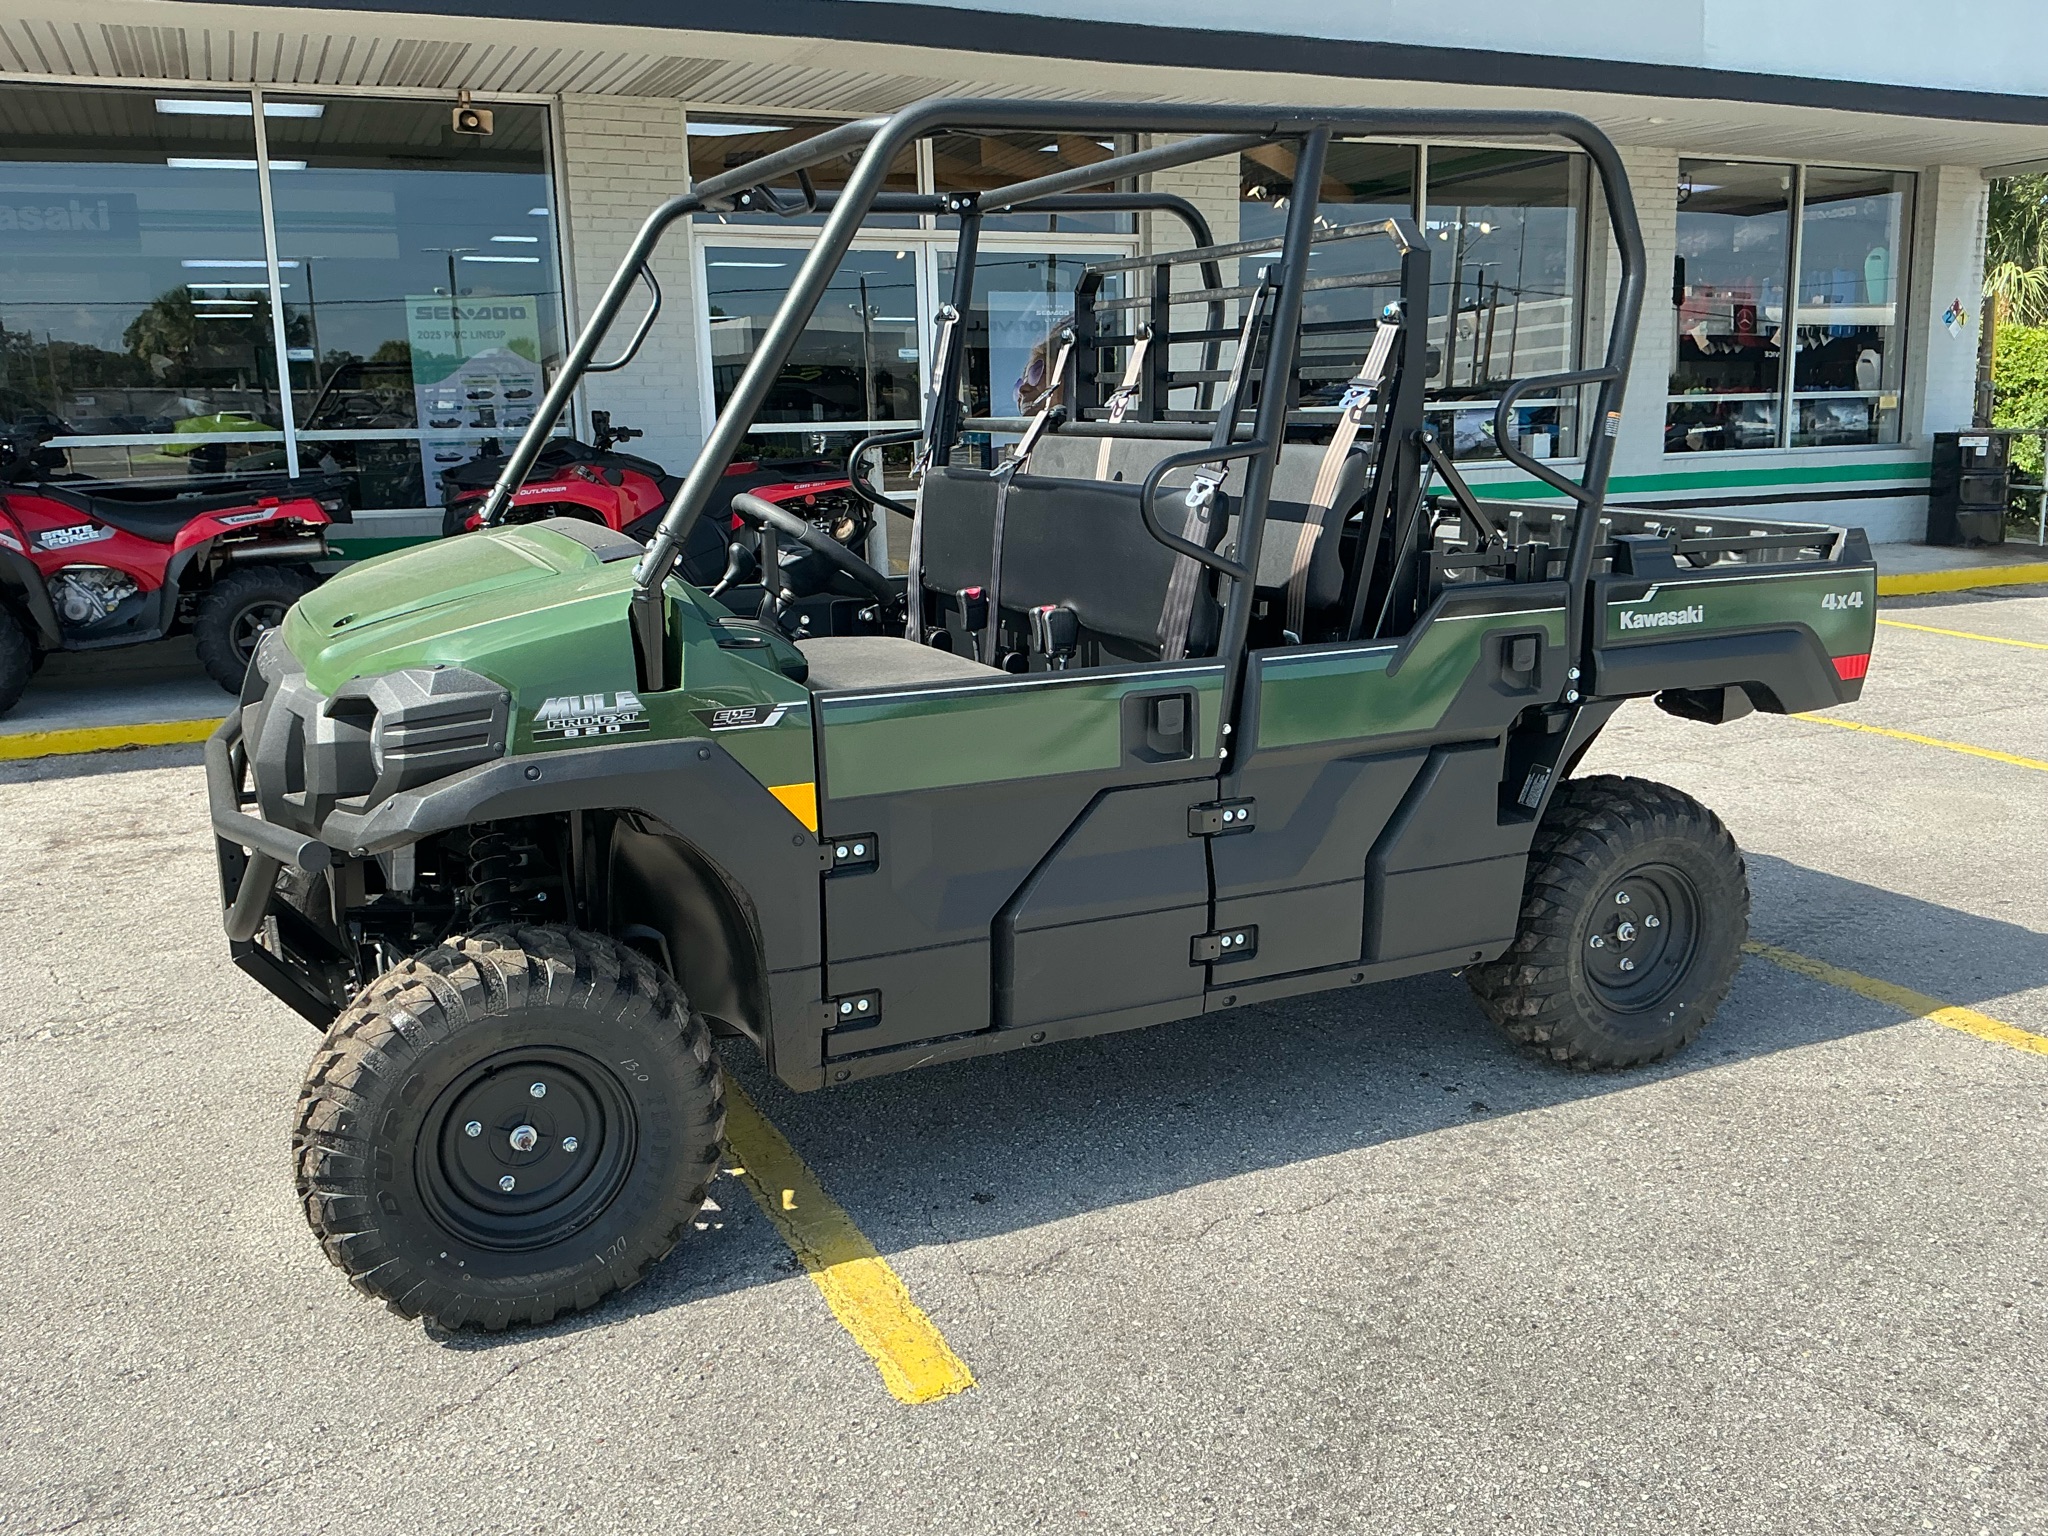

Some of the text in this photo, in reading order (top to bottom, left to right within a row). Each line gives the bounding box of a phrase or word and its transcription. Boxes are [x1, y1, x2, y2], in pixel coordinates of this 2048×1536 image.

[1945, 310, 1953, 324] 2
[1960, 312, 1965, 326] 1
[417, 330, 507, 340] 2025 PWC LINEUP
[520, 486, 567, 496] OUTLANDER
[41, 525, 93, 540] BRUTE
[48, 530, 101, 546] FORCE
[1821, 591, 1864, 610] 4x4
[1619, 605, 1704, 630] Kawasaki
[533, 691, 647, 721] MULE
[713, 708, 757, 723] EPS
[564, 724, 621, 737] 820
[375, 1073, 426, 1216] DURO
